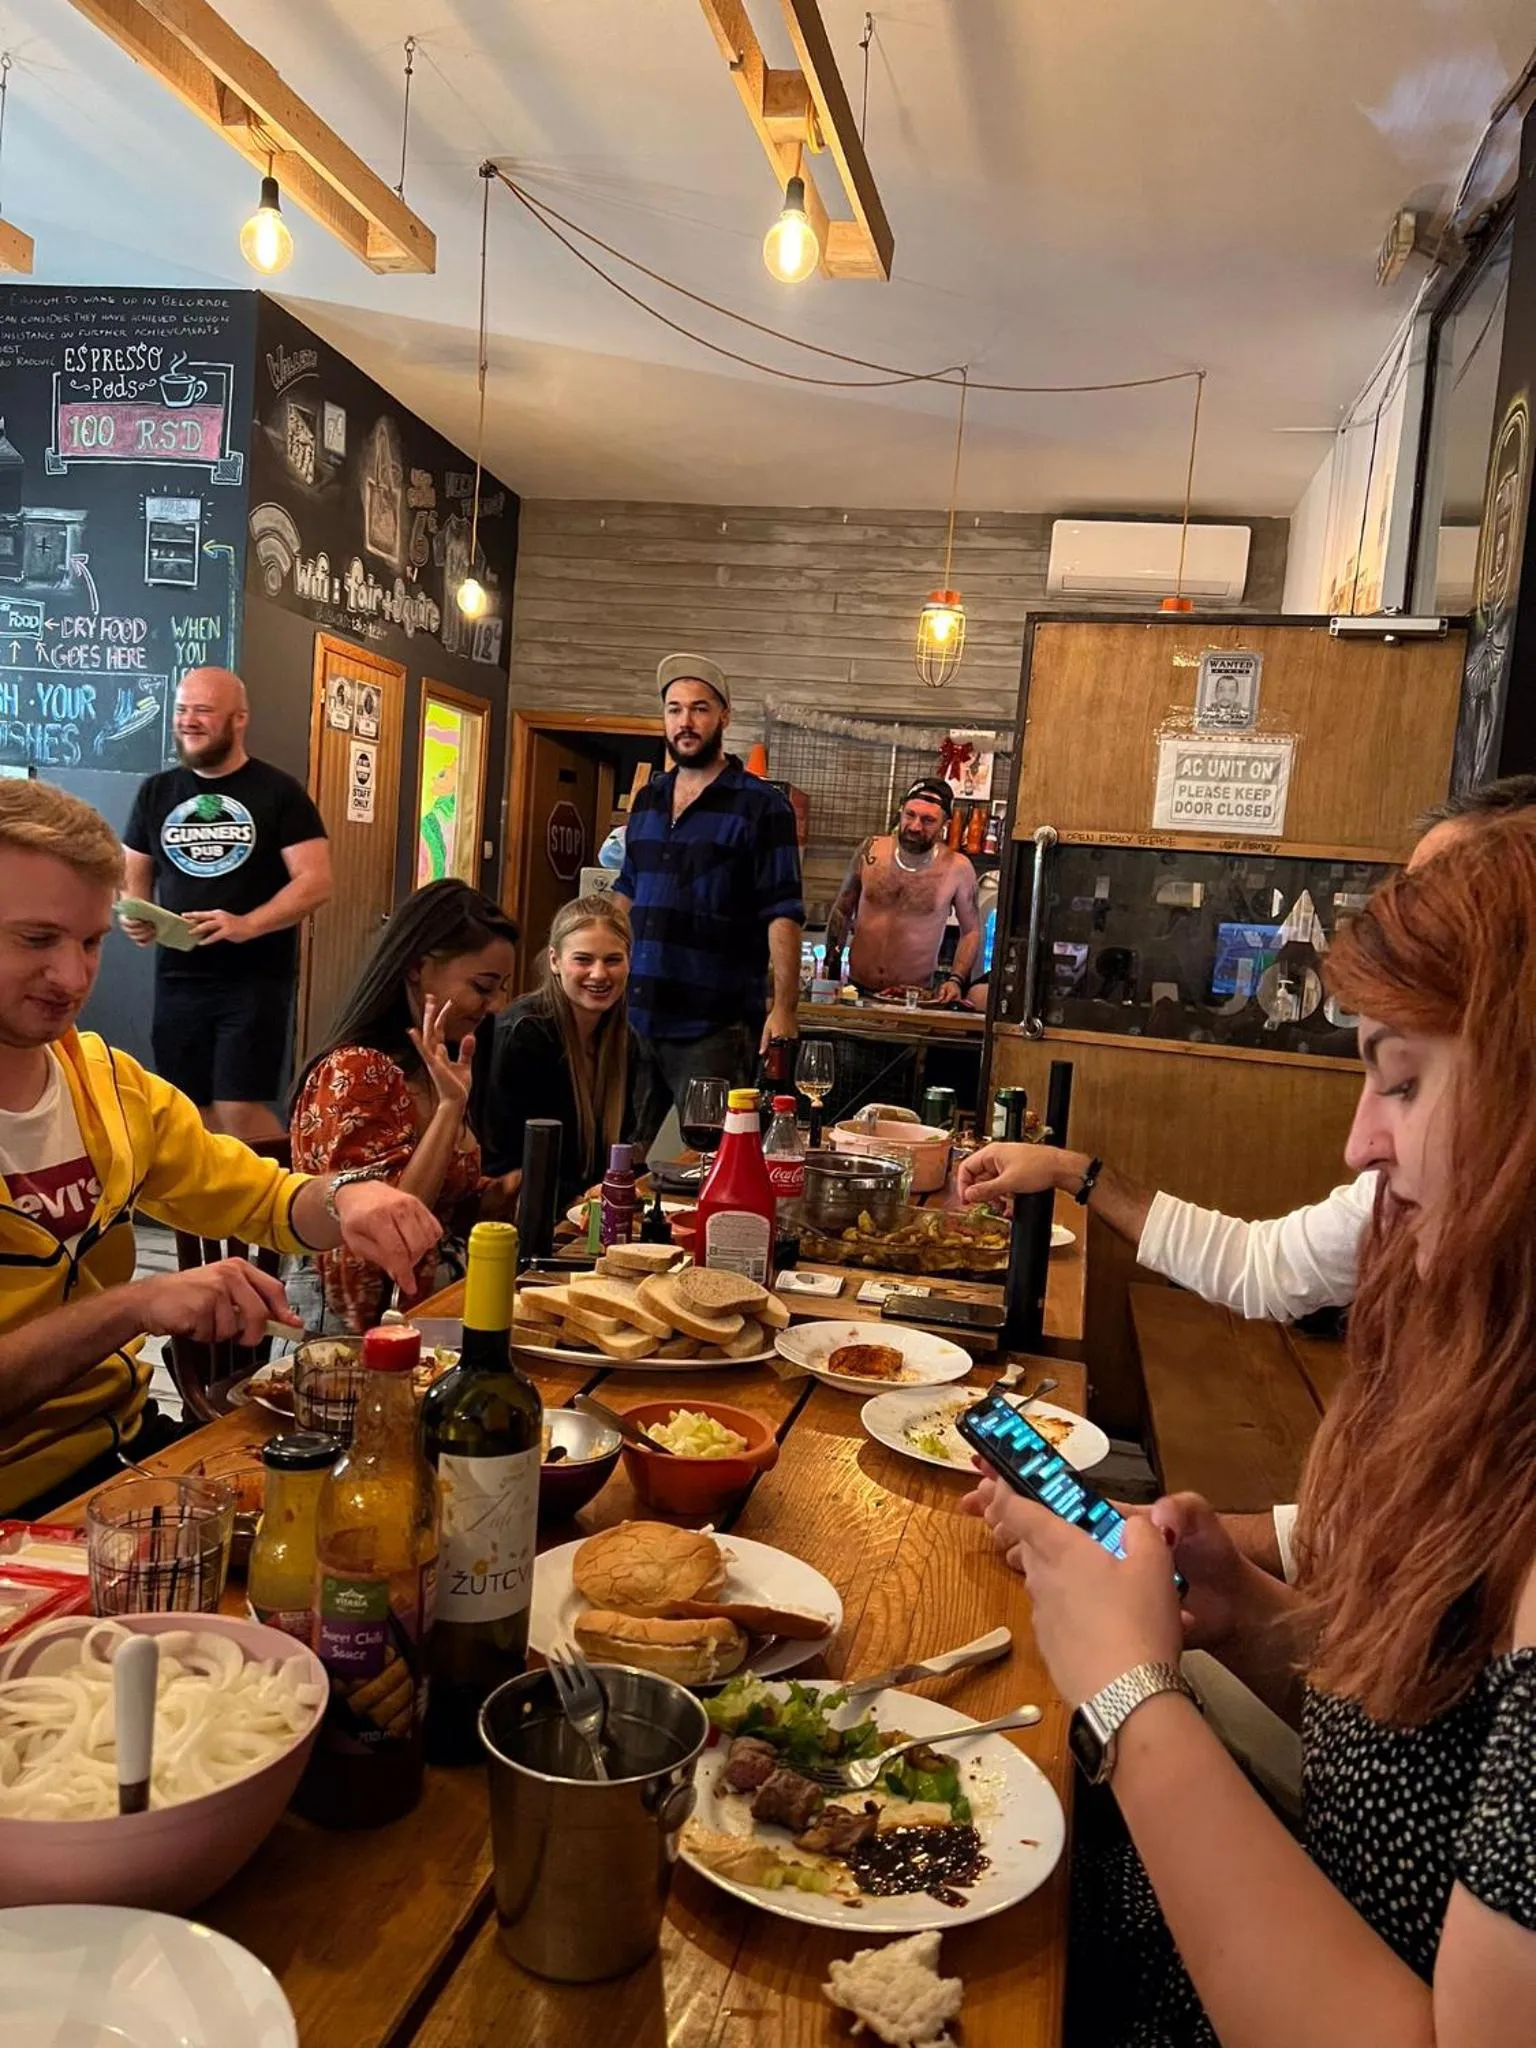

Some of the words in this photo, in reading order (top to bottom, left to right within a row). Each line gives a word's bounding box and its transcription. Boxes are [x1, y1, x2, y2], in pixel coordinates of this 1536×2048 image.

[143, 297, 156, 305] IN
[161, 295, 230, 308] BELGRADE
[74, 312, 96, 323] THEY
[64, 342, 163, 373] ESPRESSO
[91, 374, 138, 399] Pods
[68, 414, 115, 447] 100
[136, 418, 202, 451] RSD
[61, 616, 97, 639] DRY
[100, 616, 148, 644] FOOD
[171, 615, 221, 640] WHEN
[51, 644, 101, 670] GOES
[107, 645, 148, 670] HERE
[175, 641, 206, 665] YOU
[1209, 660, 1253, 669] WANTED
[37, 682, 97, 721] YOUR
[1181, 758, 1203, 777] AC
[1207, 759, 1246, 779] UNIT
[1249, 761, 1274, 780] ON
[1178, 784, 1231, 800] PLEASE
[1234, 786, 1272, 802] KEEP
[1174, 801, 1213, 815] DOOR
[1216, 803, 1273, 819] CLOSED
[164, 825, 251, 843] GUNNERS
[551, 814, 581, 856] STOP
[190, 845, 224, 860] PUB
[12, 1177, 101, 1219] evi's
